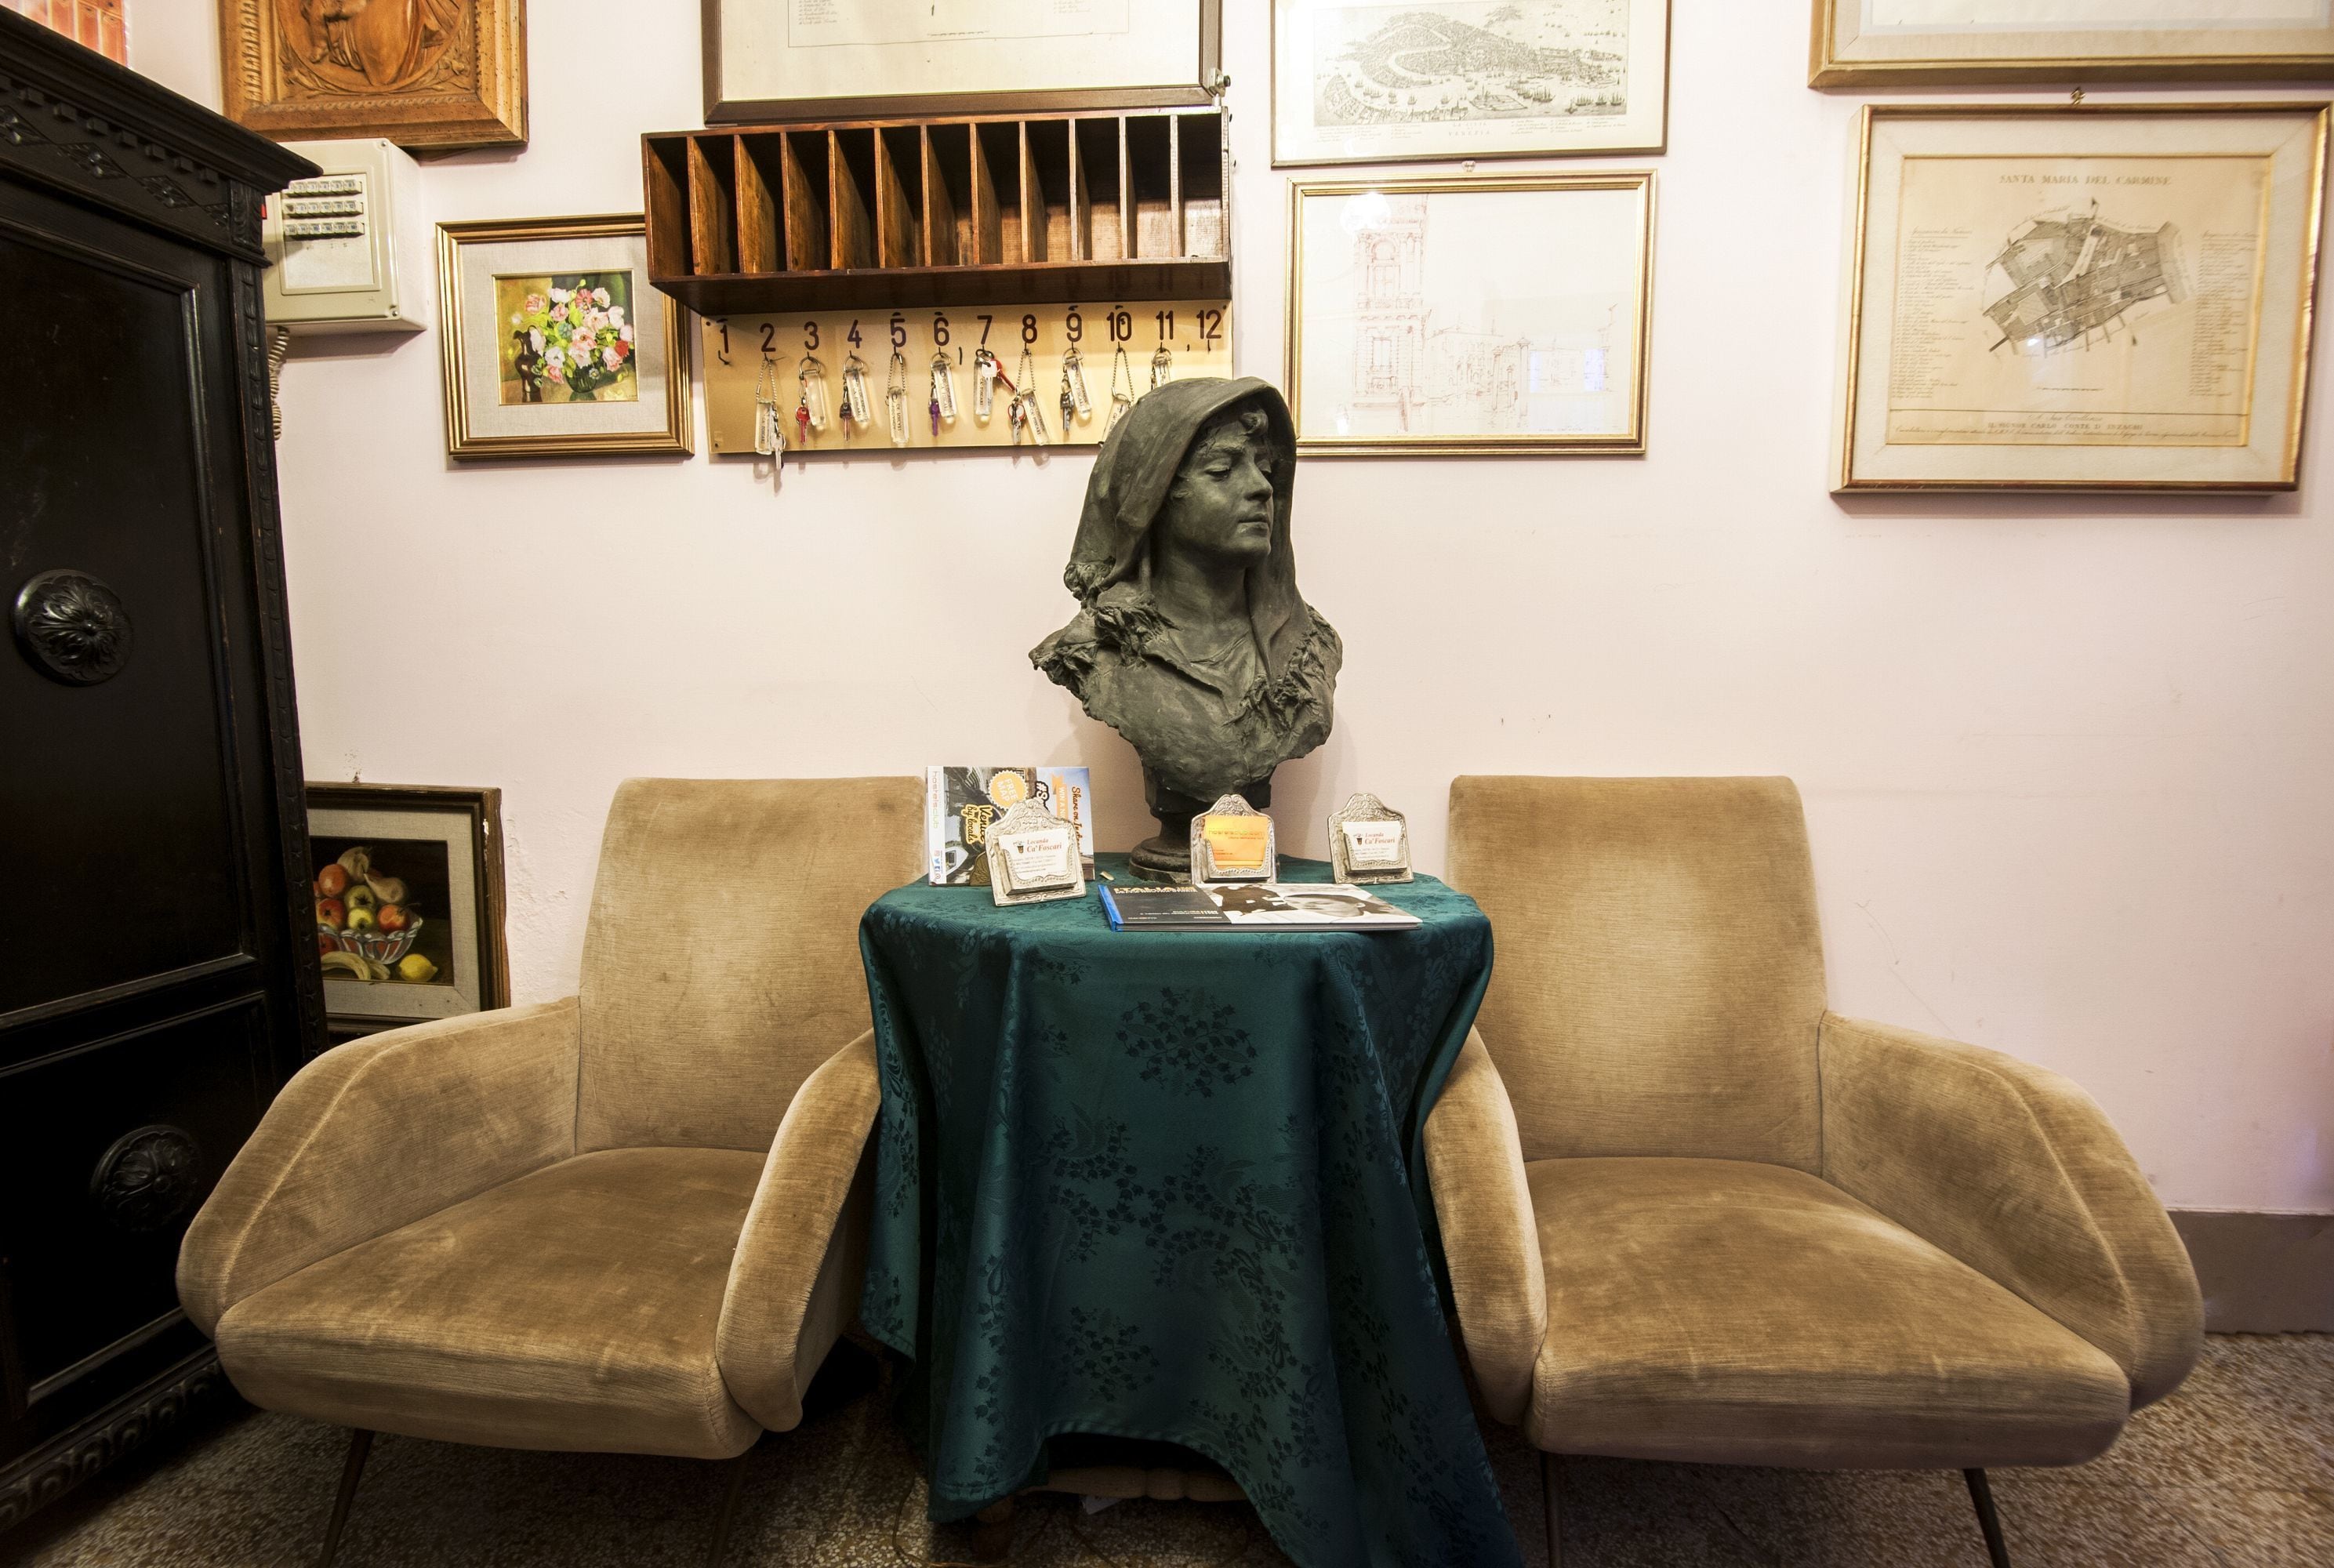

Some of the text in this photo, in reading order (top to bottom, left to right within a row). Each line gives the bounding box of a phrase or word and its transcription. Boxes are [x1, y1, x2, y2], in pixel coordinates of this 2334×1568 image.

[1999, 175, 2172, 186] SANTA MARIA DEL CARMINE
[720, 309, 1222, 354] 1 2 3 4 5 6 7 8 9 10 11 12
[996, 780, 1011, 802] MAP
[1004, 778, 1018, 800] FREE
[1071, 786, 1082, 812] Share
[965, 805, 978, 842] by locals
[1038, 844, 1062, 852] Foscari
